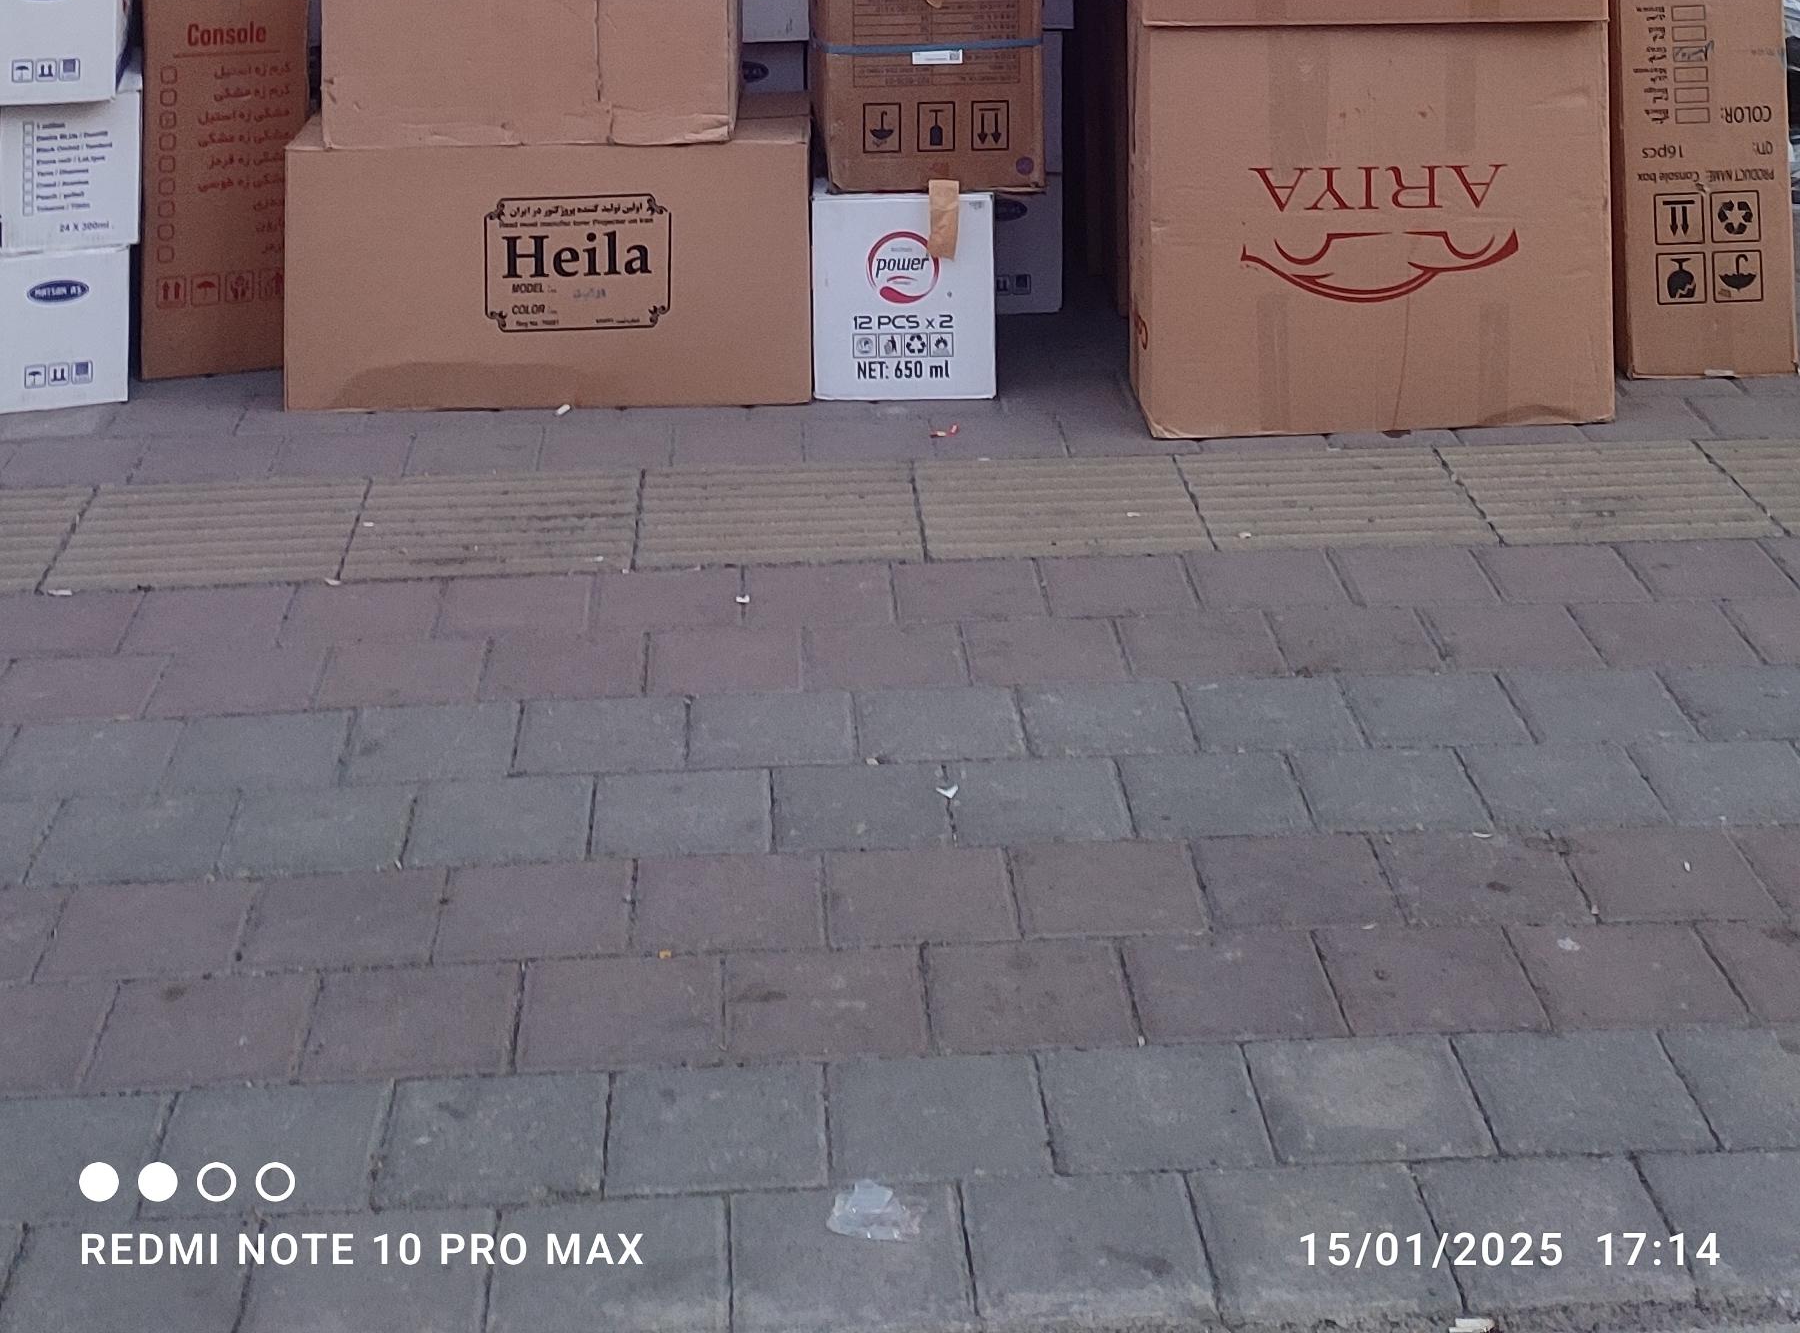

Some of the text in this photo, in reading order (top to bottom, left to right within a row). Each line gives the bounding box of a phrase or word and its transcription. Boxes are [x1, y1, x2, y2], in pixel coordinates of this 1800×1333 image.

[187, 21, 267, 47] Console
[1720, 105, 1773, 124] COLOR:
[1642, 143, 1684, 160] 16pcs
[1637, 171, 1658, 183] box
[1660, 170, 1700, 183] Console
[1735, 168, 1776, 182] PRODUCT
[1249, 163, 1508, 213] ARIYA
[501, 230, 652, 279] Heila
[875, 253, 930, 278] power
[511, 283, 545, 293] MODEL
[511, 304, 546, 315] COLOR
[853, 315, 873, 330] 12
[877, 315, 920, 330] PCS
[939, 315, 954, 329] 2
[857, 360, 951, 380] NET: 650 ml
